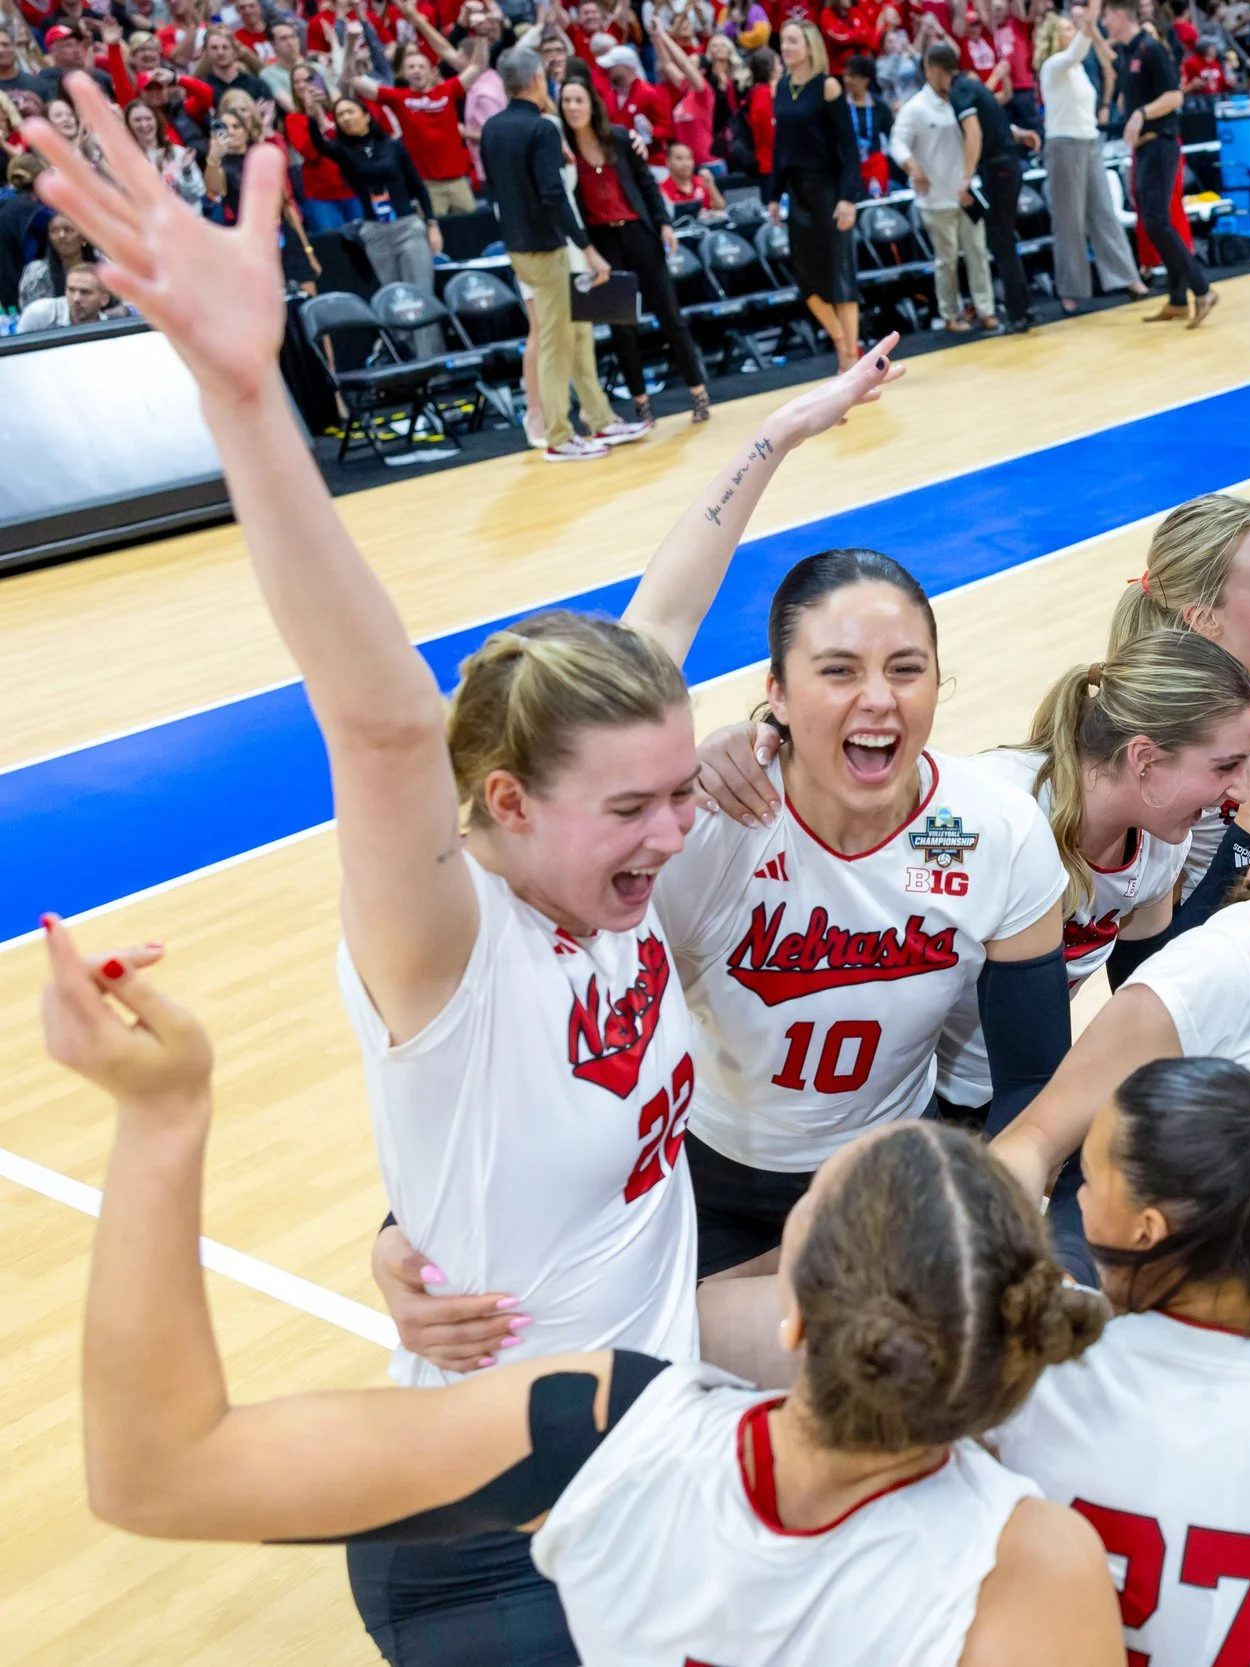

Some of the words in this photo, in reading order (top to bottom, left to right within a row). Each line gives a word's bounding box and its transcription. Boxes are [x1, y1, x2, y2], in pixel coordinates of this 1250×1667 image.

[754, 437, 774, 460] fly
[914, 837, 975, 846] CHAMPIONSHIP
[727, 901, 959, 970] Nebraska
[771, 1020, 882, 1094] 10
